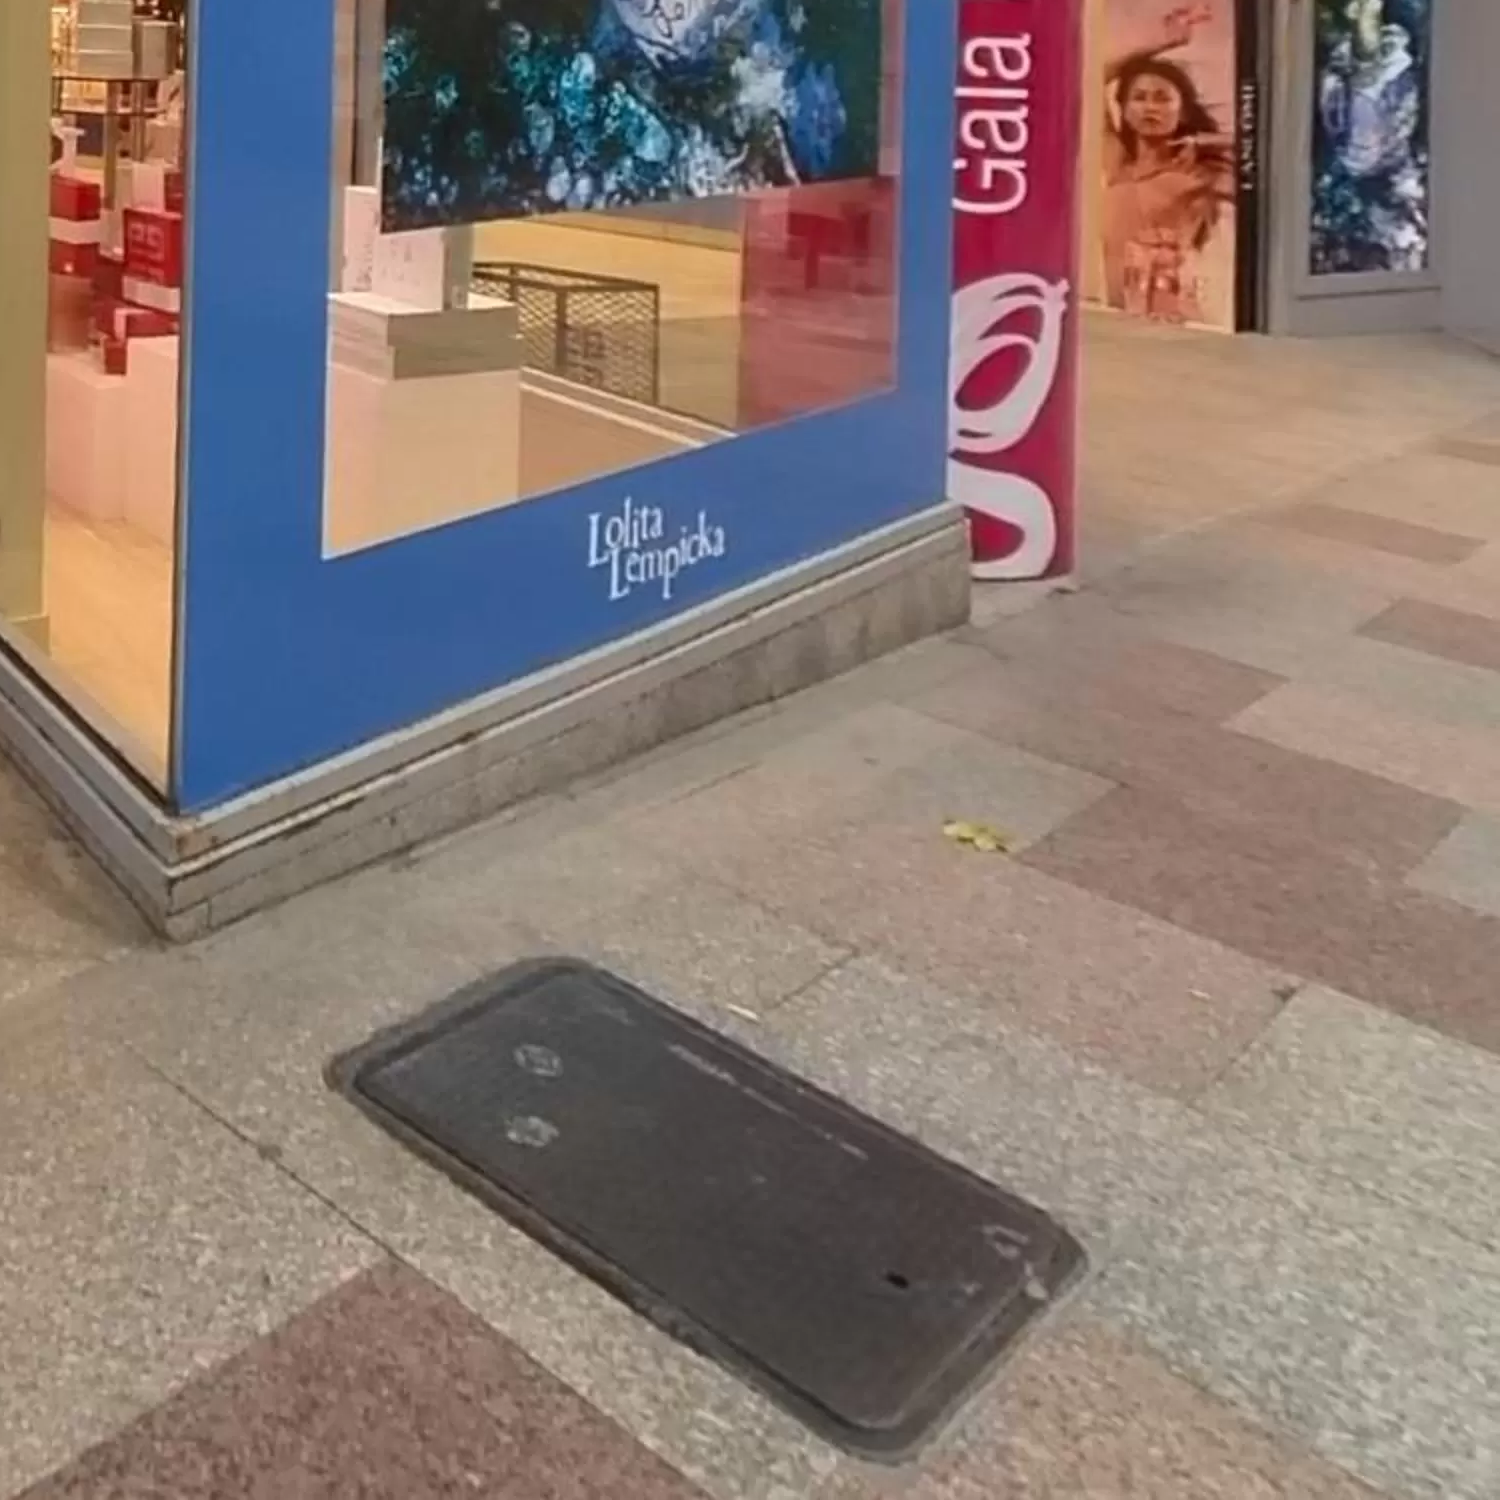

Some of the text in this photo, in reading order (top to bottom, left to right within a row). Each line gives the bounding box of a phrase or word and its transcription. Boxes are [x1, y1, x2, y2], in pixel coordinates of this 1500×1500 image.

[951, 32, 1031, 216] Gala
[587, 496, 663, 567] Lolita
[609, 509, 725, 600] Lempicka
